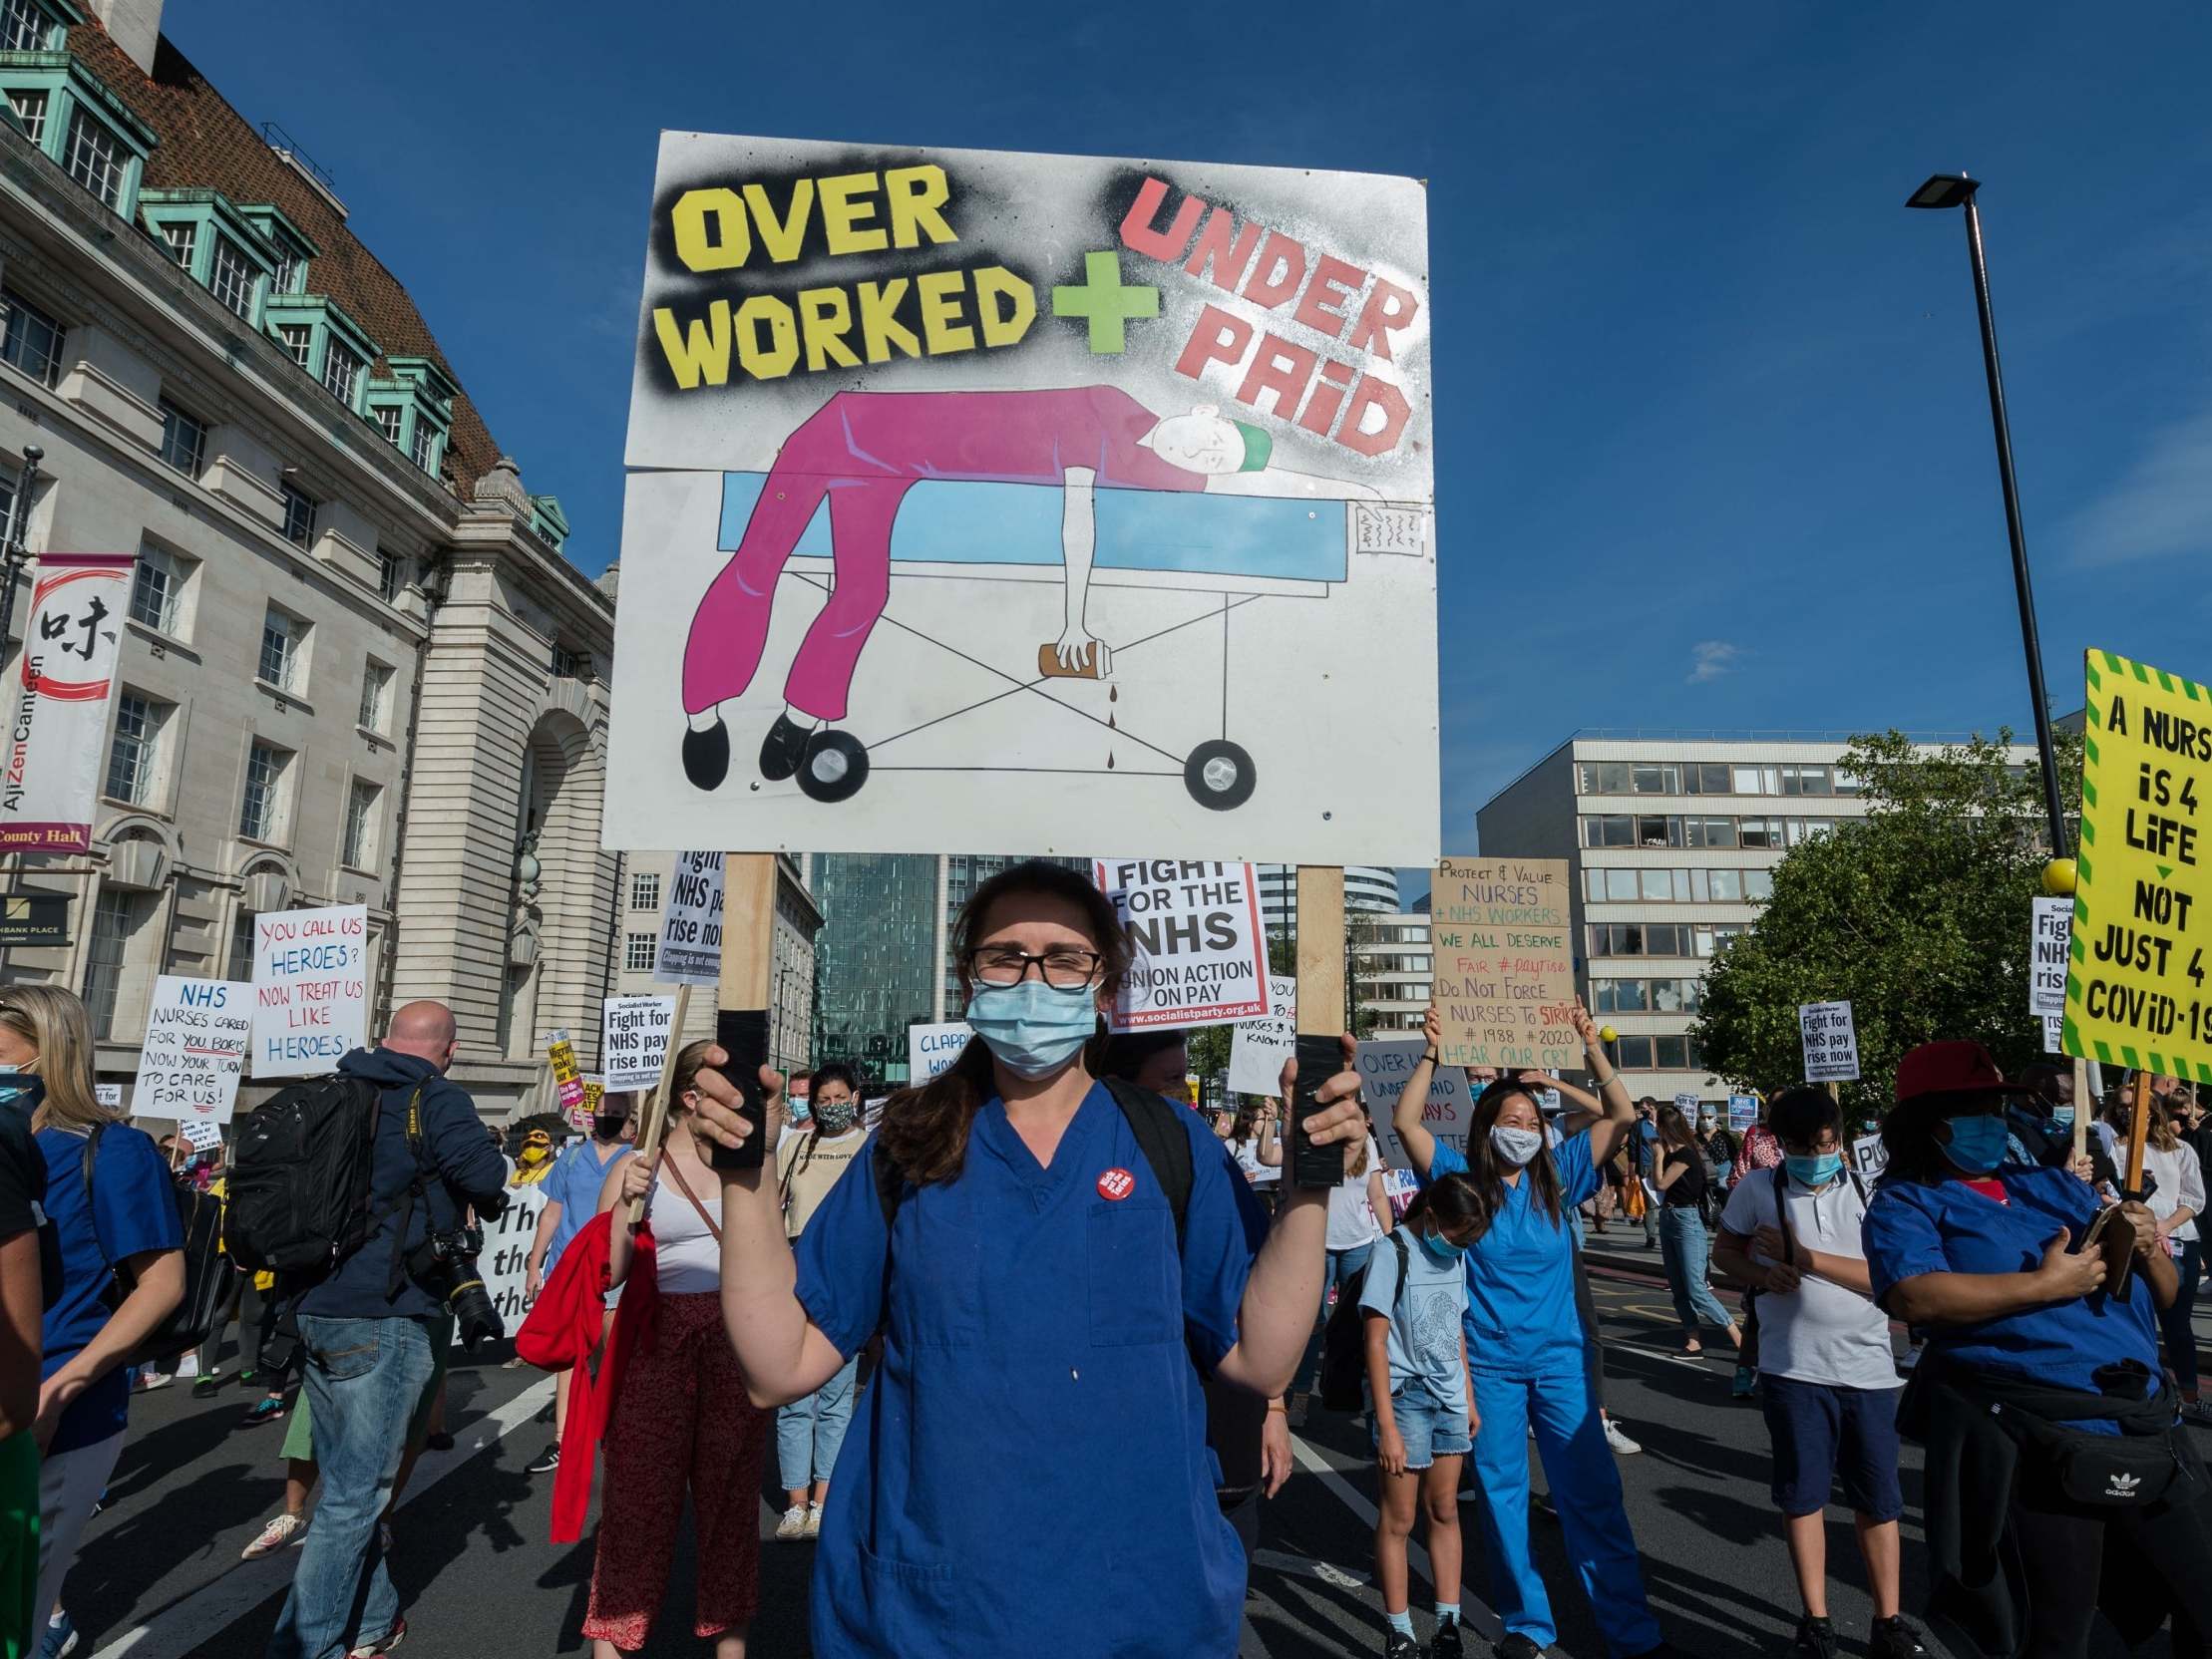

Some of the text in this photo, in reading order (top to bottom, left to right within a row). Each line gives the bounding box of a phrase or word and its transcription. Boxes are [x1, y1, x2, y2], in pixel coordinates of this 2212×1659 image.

[672, 165, 958, 272] OVER
[1118, 176, 1419, 361] UNDER
[653, 265, 1037, 389] WORKED
[41, 595, 117, 662] 味
[2107, 695, 2128, 737] A
[2177, 777, 2198, 817] 4
[47, 830, 80, 842] Hall
[1117, 860, 1224, 889] FIGHT
[673, 873, 709, 908] NHS
[1113, 881, 1243, 913] FOR THE
[1462, 884, 1538, 905] NURSES
[1450, 905, 1482, 922] NHS
[1487, 906, 1562, 925] WORKERS
[2134, 879, 2193, 932] NOT
[260, 917, 362, 952] YOU CALL US
[666, 910, 722, 947] rise no
[1125, 911, 1238, 957] NHS
[1439, 932, 1563, 948] WE ALL DESERVE
[271, 944, 360, 976] HEROES?
[2037, 941, 2071, 964] NH
[2094, 924, 2205, 988] JUST 4
[1121, 960, 1253, 990] UNION ACTION
[2036, 967, 2068, 988] ris
[180, 984, 227, 1008] NHS
[258, 980, 364, 1007] NOW TREAT US
[1154, 983, 1223, 1007] ON PAY
[1270, 980, 1295, 997] YOU
[1465, 977, 1496, 997] NOT
[1504, 977, 1548, 1000] FORCE
[153, 1007, 249, 1031] NURSES CARED
[288, 1006, 331, 1028] LIKE
[608, 1009, 670, 1032] Fight for
[1117, 1003, 1261, 1026] www.socialistparty.org.uk
[1274, 1004, 1286, 1017] TO
[1450, 1004, 1516, 1024] NURSES
[1803, 1013, 1847, 1032] Fight for
[148, 1029, 176, 1046] FOR
[211, 1037, 245, 1054] BORIS
[609, 1032, 668, 1052] NHS pay
[1247, 1033, 1279, 1046] KNOW
[1804, 1032, 1849, 1049] NHS pay
[145, 1051, 242, 1074] NOW YOUR TURN
[609, 1053, 637, 1070] rise
[1363, 1054, 1406, 1074] OVER
[1445, 1045, 1491, 1068] HEAR
[1500, 1046, 1536, 1067] OUR
[1542, 1049, 1570, 1068] CRY
[1807, 1049, 1852, 1064] rise now
[143, 1072, 216, 1087] TO CARE
[105, 1092, 118, 1101] for
[153, 1088, 222, 1105] FOR US!
[2105, 1489, 2136, 1497] adidas
